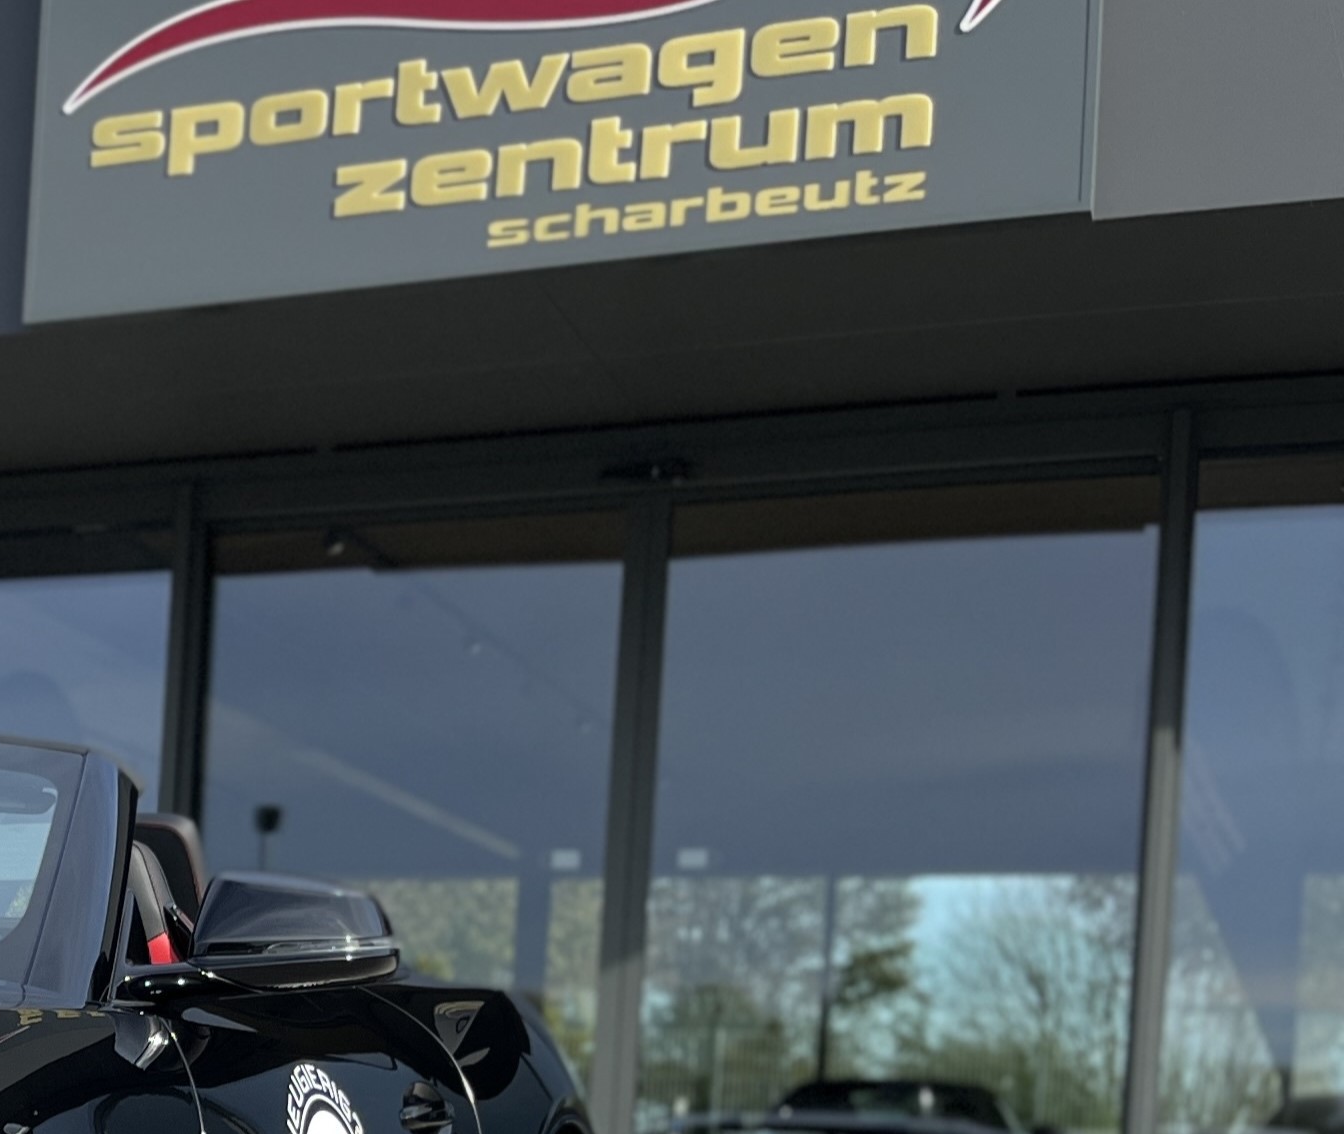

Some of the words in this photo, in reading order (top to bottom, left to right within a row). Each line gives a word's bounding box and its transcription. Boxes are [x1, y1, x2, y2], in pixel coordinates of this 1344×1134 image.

[89, 3, 938, 176] sportwagen
[332, 92, 933, 218] zentrum
[486, 170, 927, 247] scharbeutz
